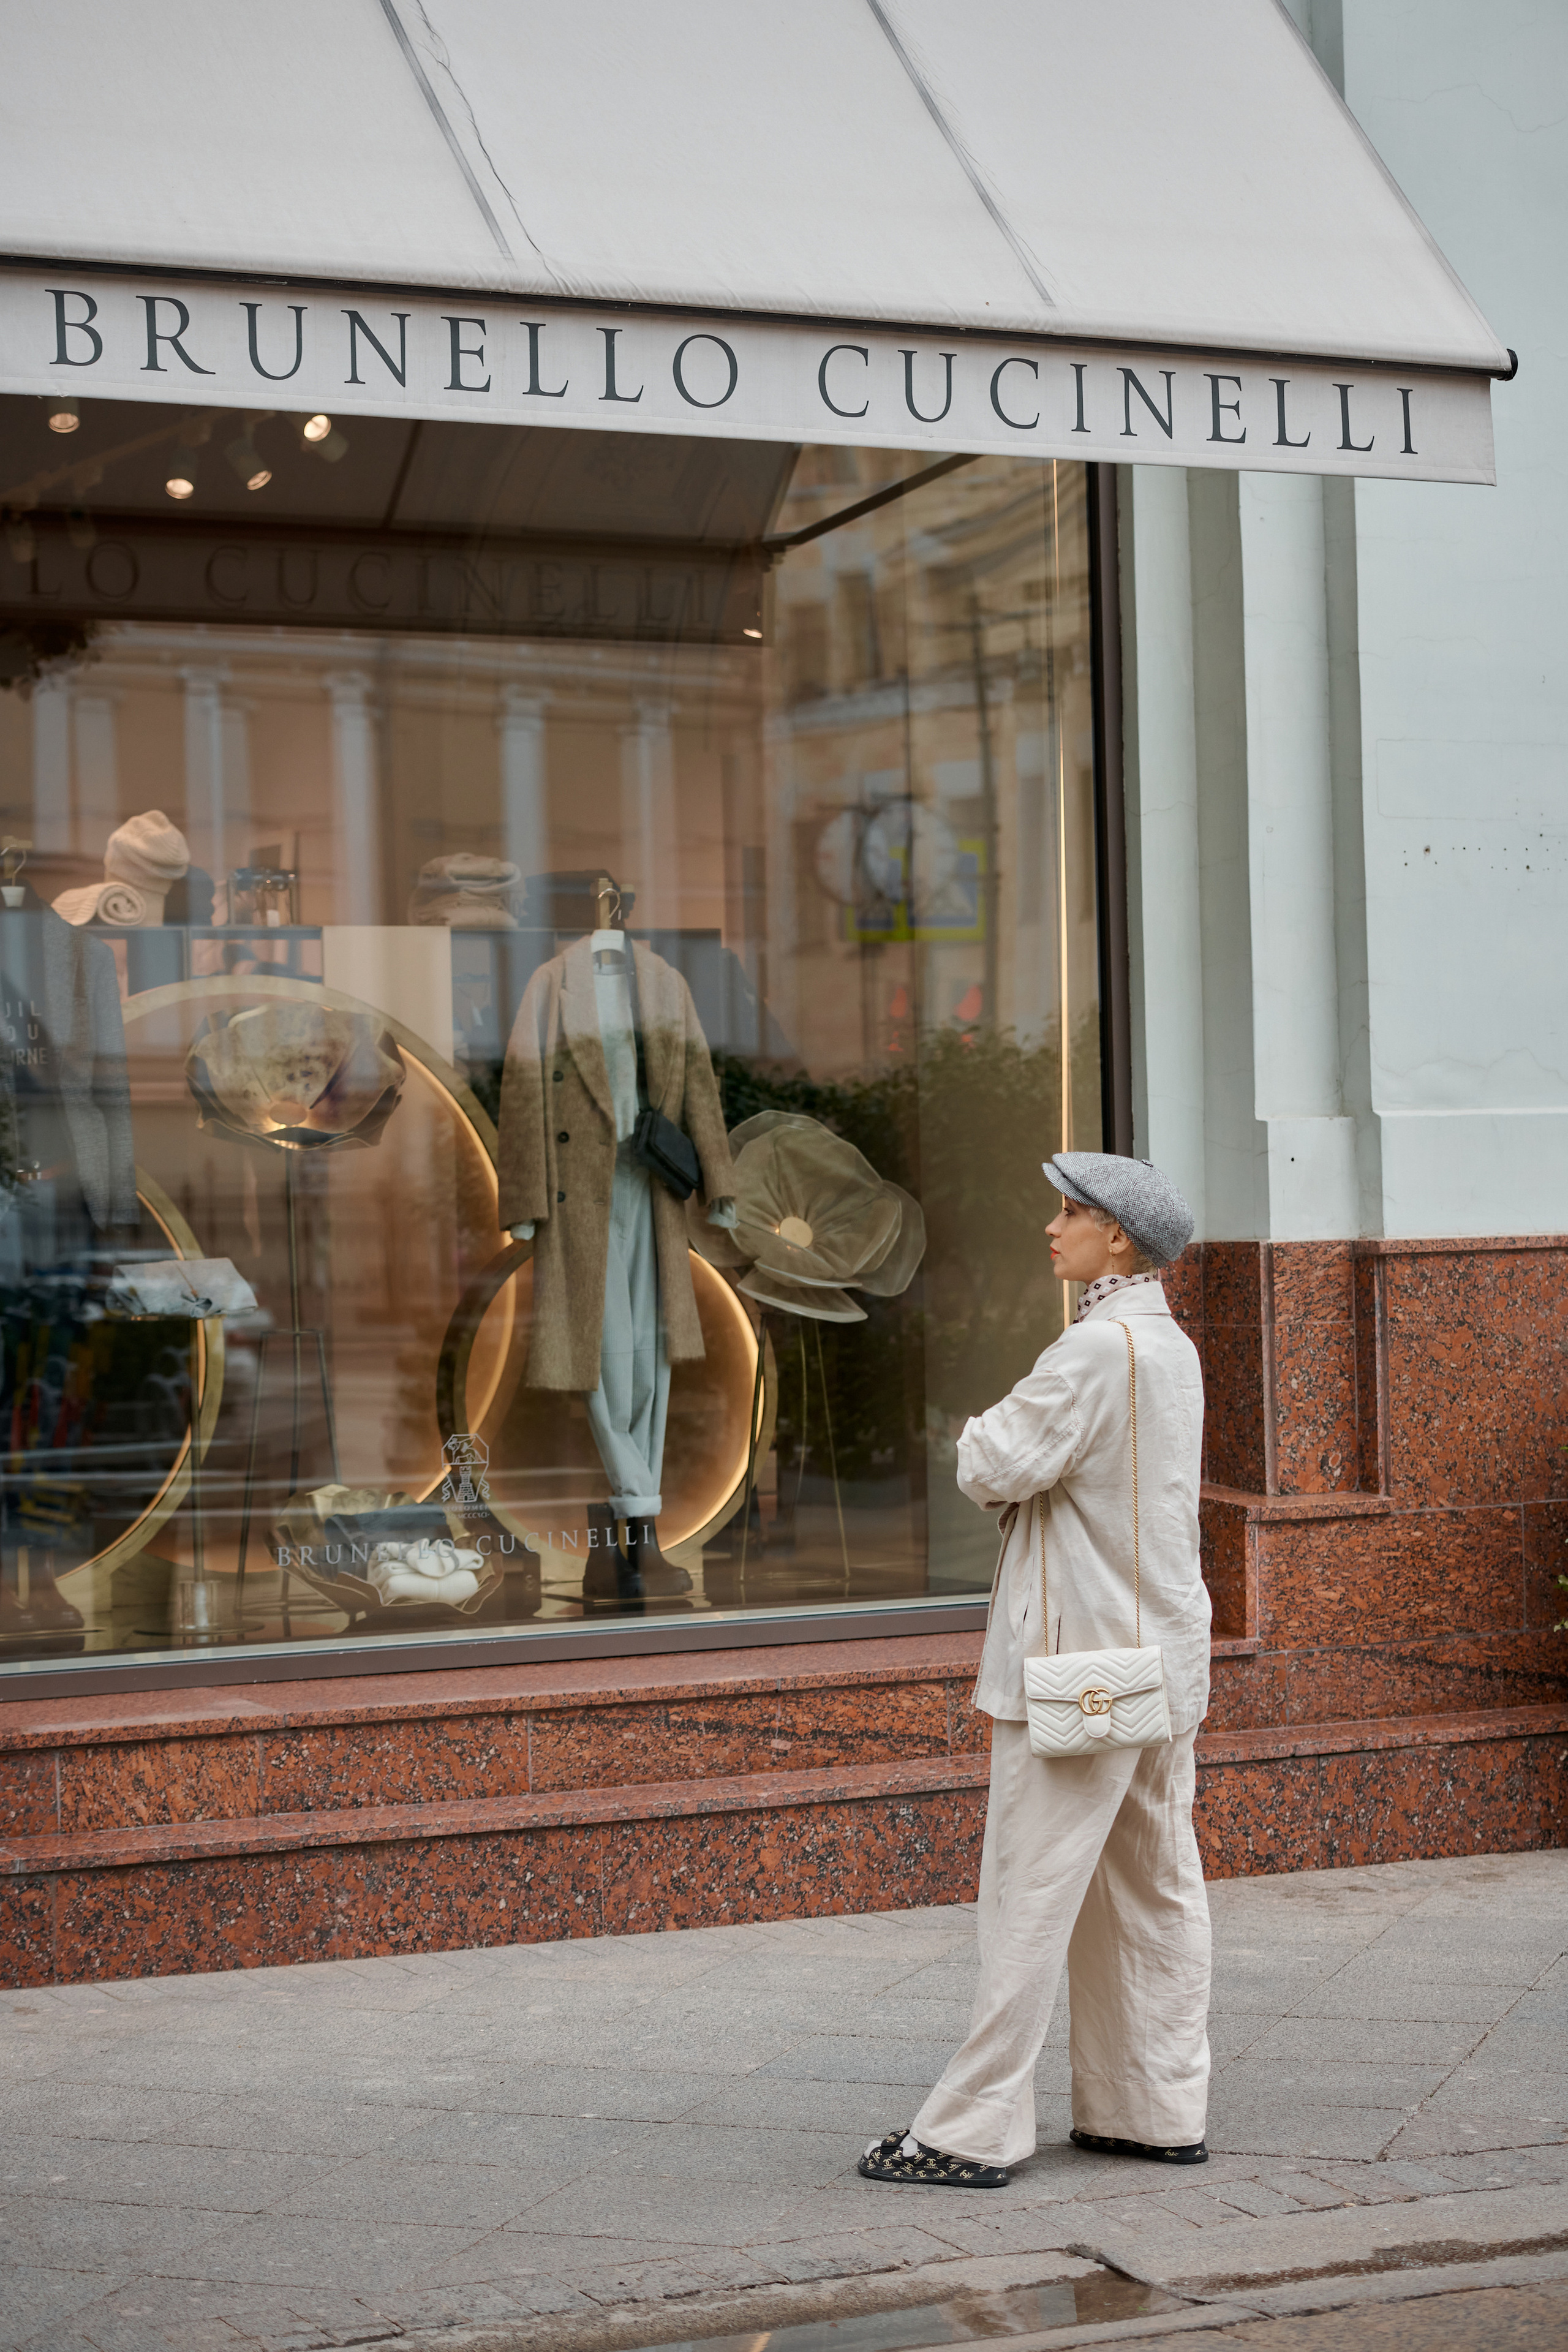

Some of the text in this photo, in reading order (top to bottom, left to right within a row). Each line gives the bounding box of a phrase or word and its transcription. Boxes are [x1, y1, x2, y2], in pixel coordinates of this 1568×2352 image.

[45, 288, 1419, 455] BRUNELLO CUCINELLI
[277, 1525, 649, 1567] BRUNELLO CUCINELLI
